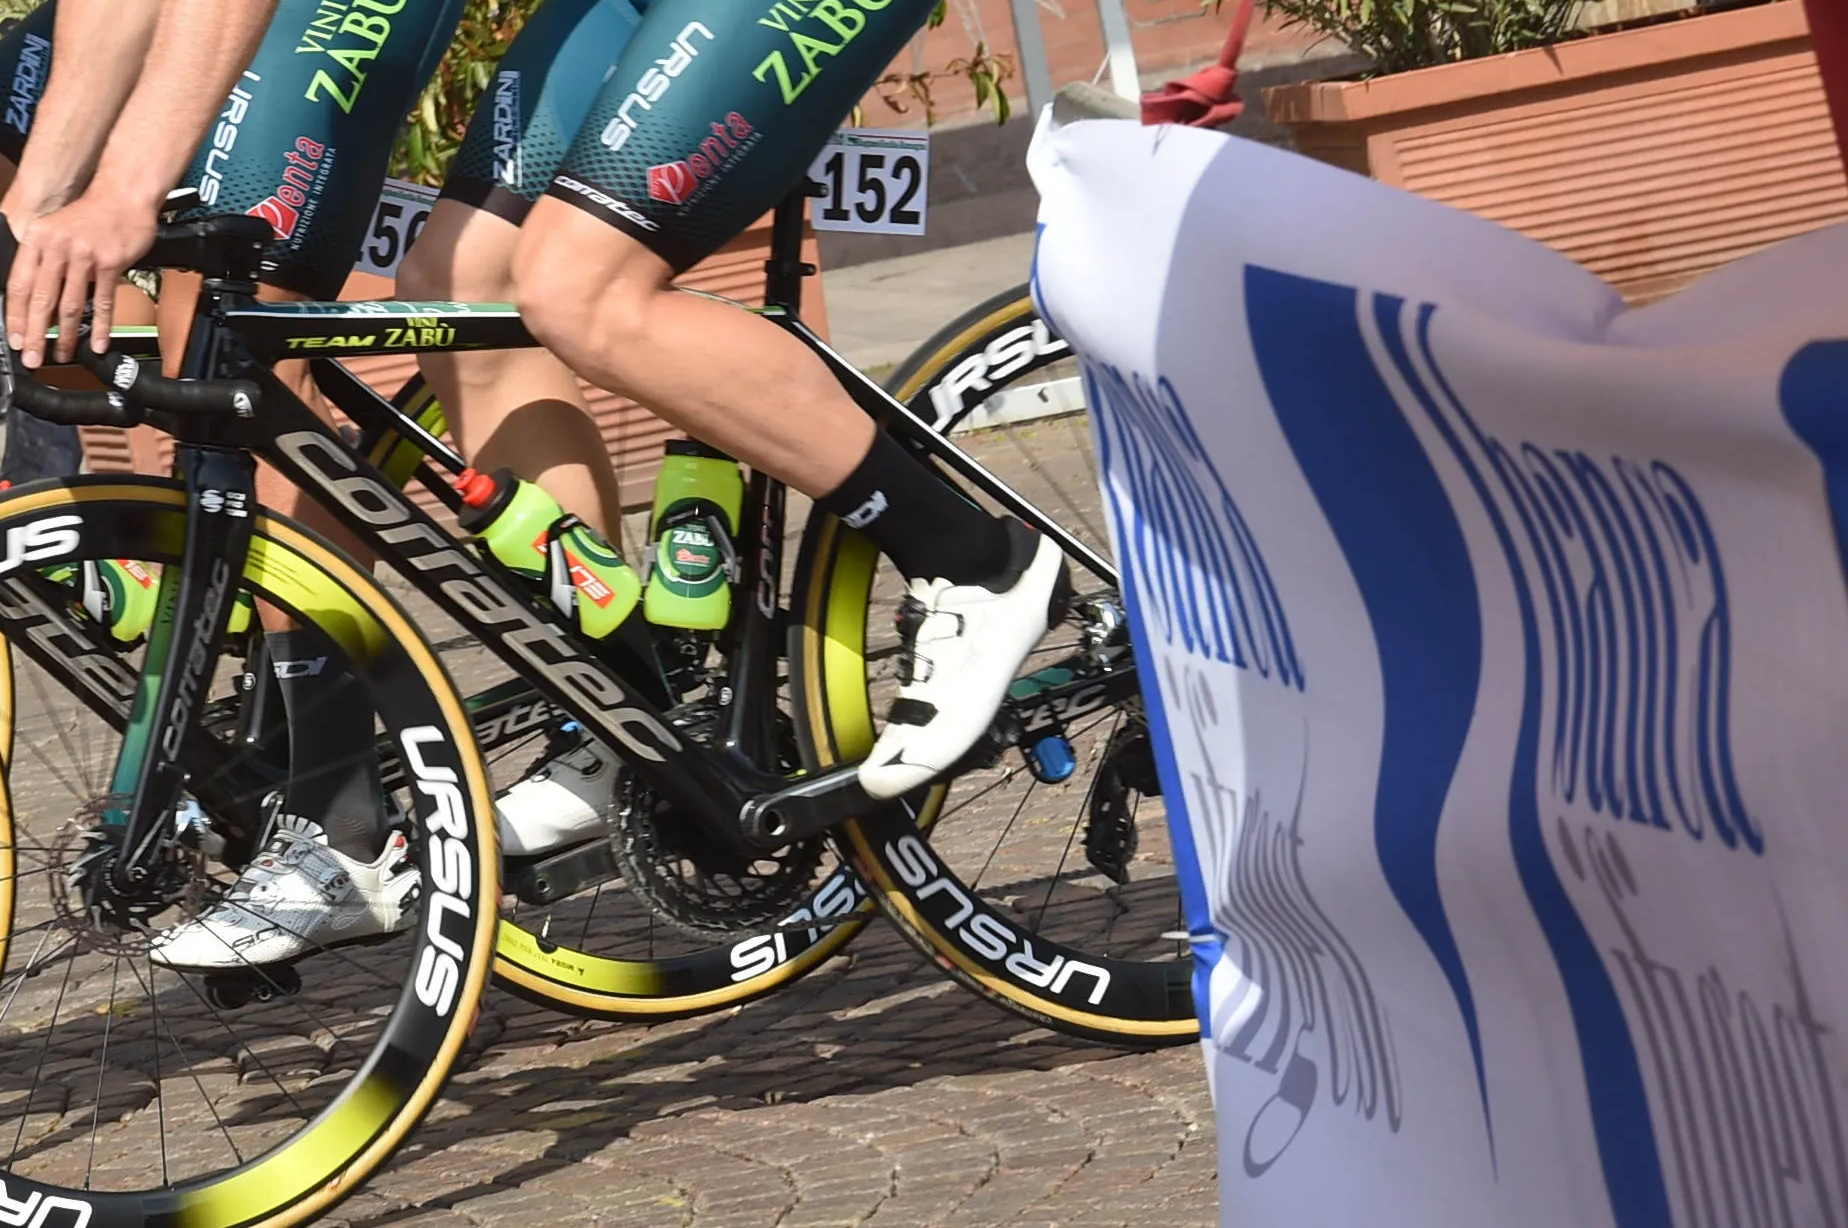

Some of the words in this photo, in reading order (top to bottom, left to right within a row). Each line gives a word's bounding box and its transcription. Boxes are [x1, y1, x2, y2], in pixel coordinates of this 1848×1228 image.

[493, 71, 520, 184] ZARDINI
[600, 21, 715, 151] URSUS
[290, 196, 319, 250] NUTRIZIONE
[310, 146, 337, 196] INTEGRATA
[554, 174, 661, 232] corratec
[823, 152, 921, 225] 152
[286, 334, 376, 350] TEAM
[384, 323, 456, 348] ZABÙ
[275, 431, 683, 762] corratec
[164, 559, 231, 762] corratec
[400, 724, 474, 1016] URSUS
[885, 832, 1112, 1007] URSUS
